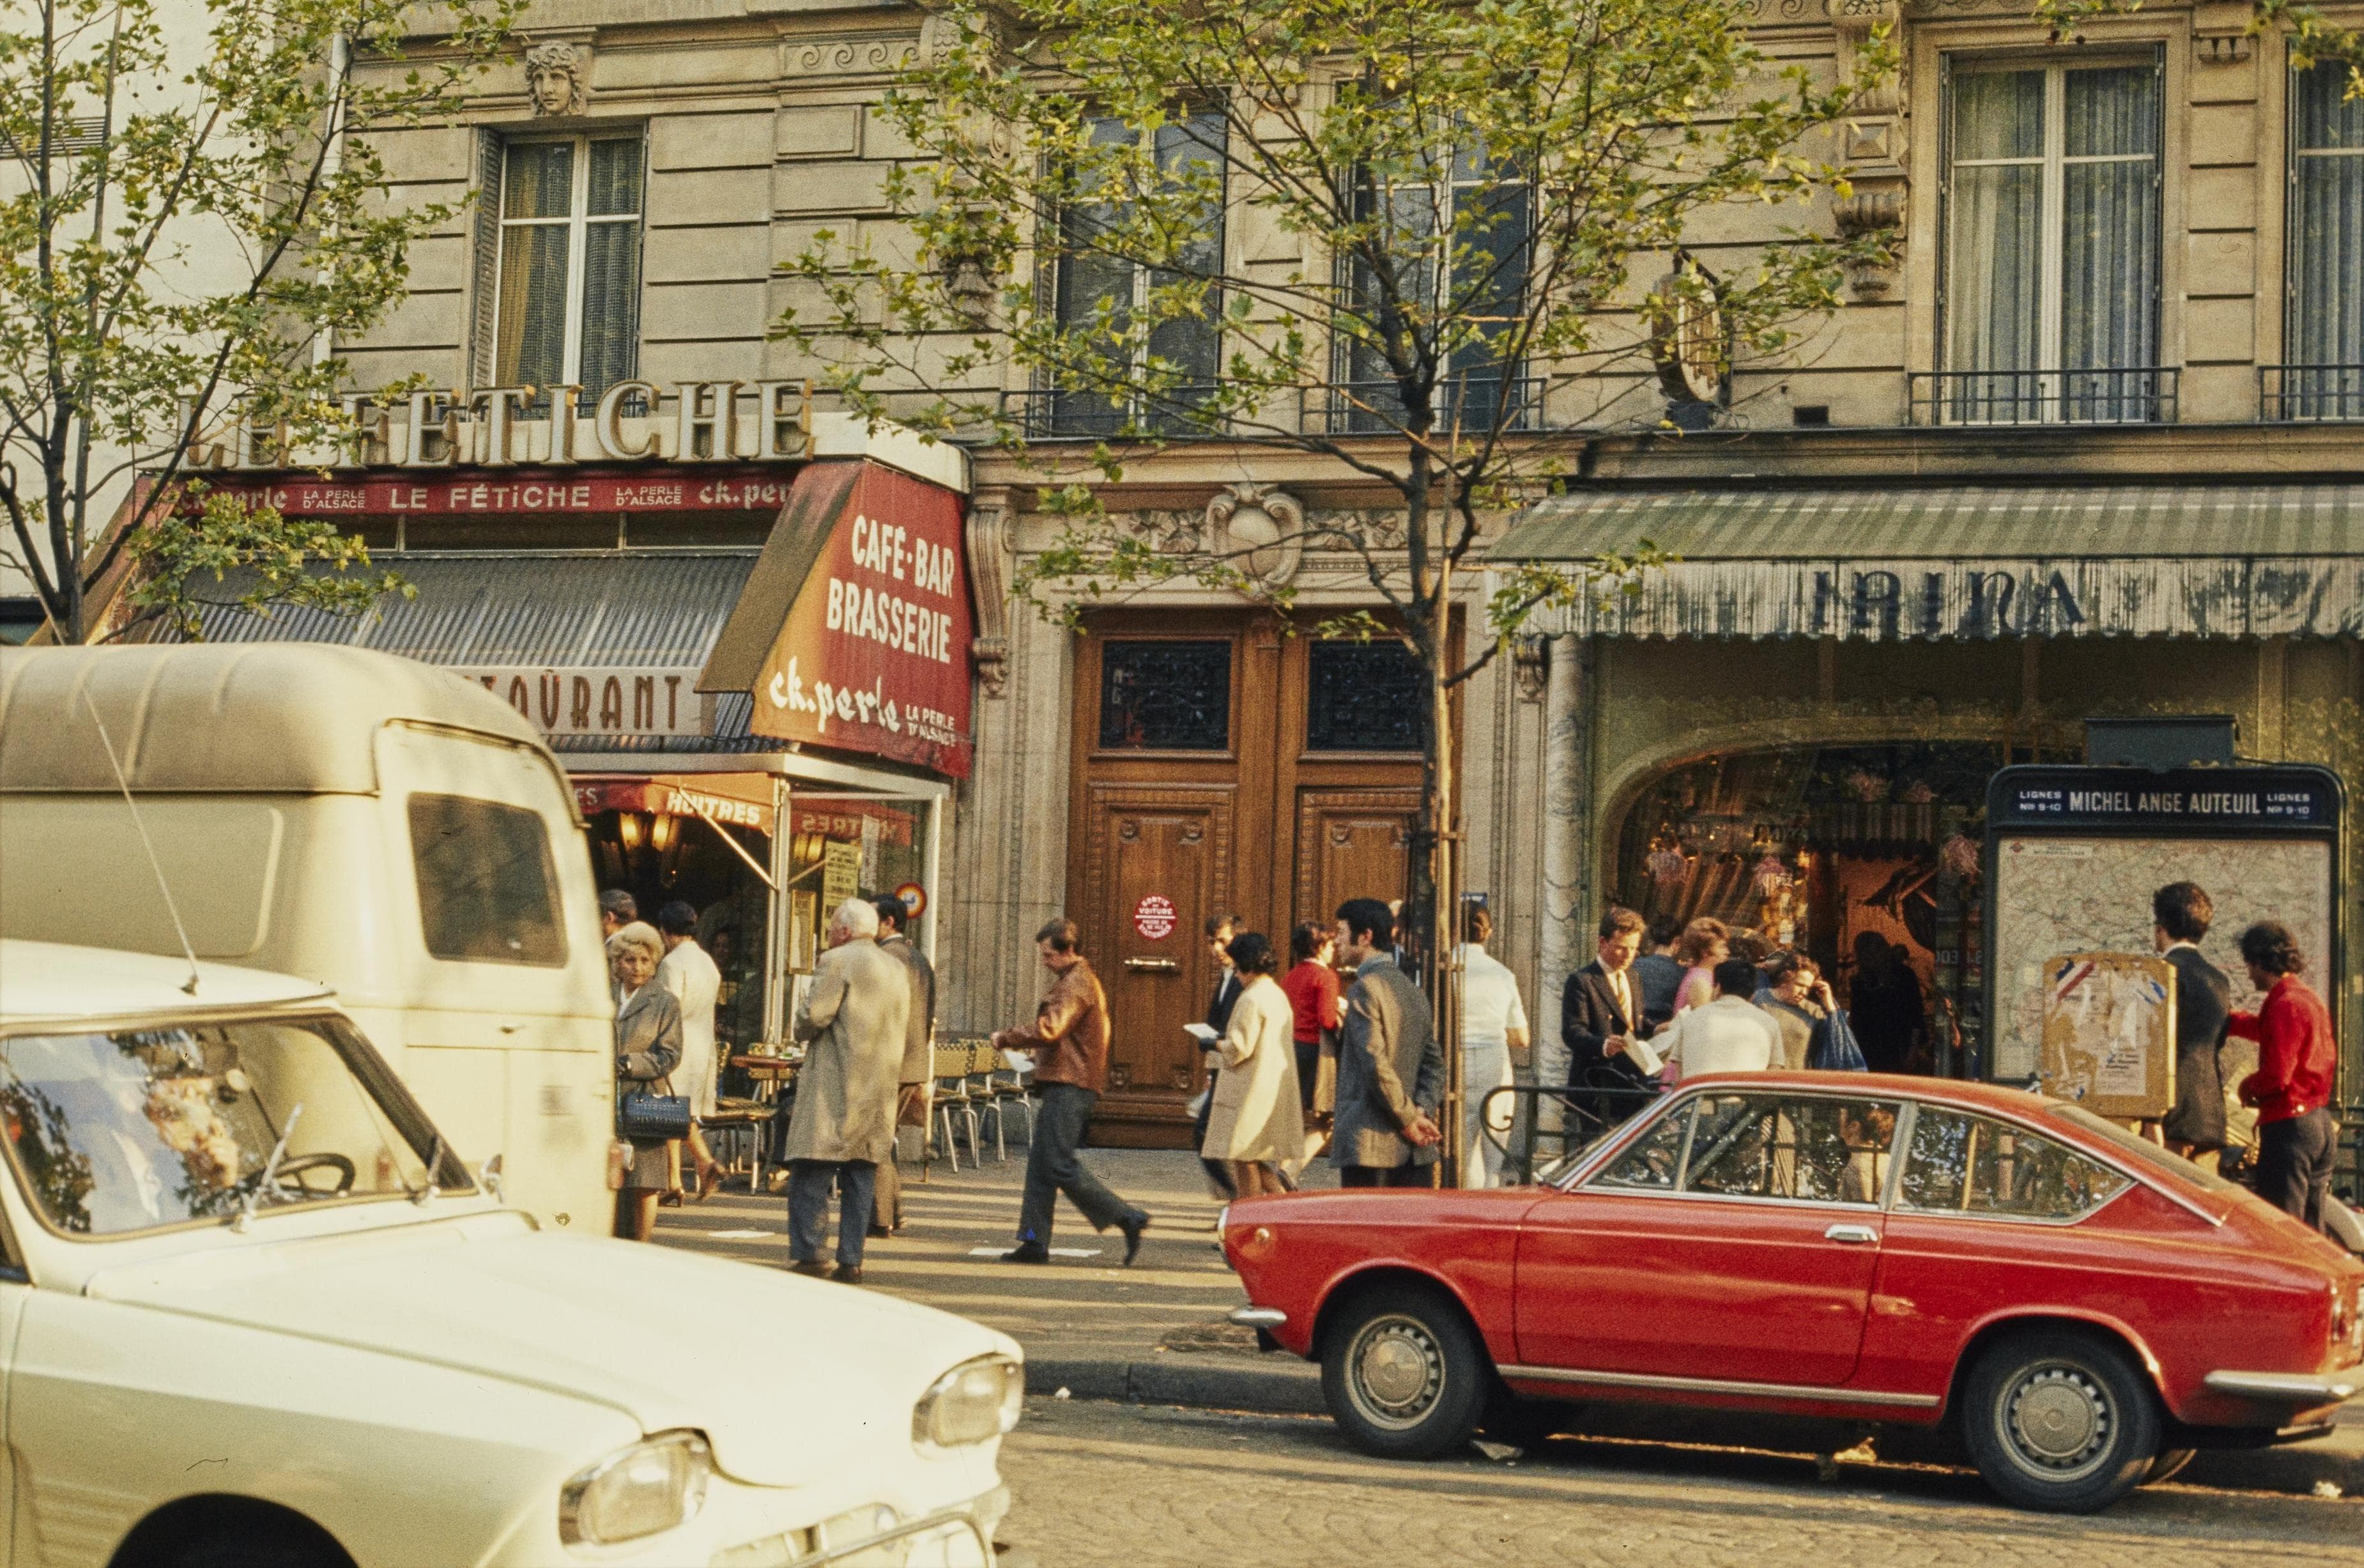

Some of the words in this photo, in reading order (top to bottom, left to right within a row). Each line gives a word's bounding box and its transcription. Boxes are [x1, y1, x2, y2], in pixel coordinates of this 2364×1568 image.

[303, 489, 319, 500] LA
[325, 489, 365, 500] PERLE
[617, 487, 633, 496] LA
[640, 486, 682, 496] PERLE
[302, 499, 365, 509] D'ALSACE
[390, 488, 428, 509] LE
[616, 495, 682, 507] D'ALSACE
[827, 578, 952, 663] BRASSERIE
[905, 705, 921, 721] LA
[921, 708, 955, 729] PERLE
[2019, 790, 2062, 799] LIGNES
[2266, 793, 2310, 803] LIGNES
[2069, 791, 2132, 812] MICHEL
[2138, 792, 2183, 813] ANGE
[2189, 793, 2261, 814] AUTEUIL
